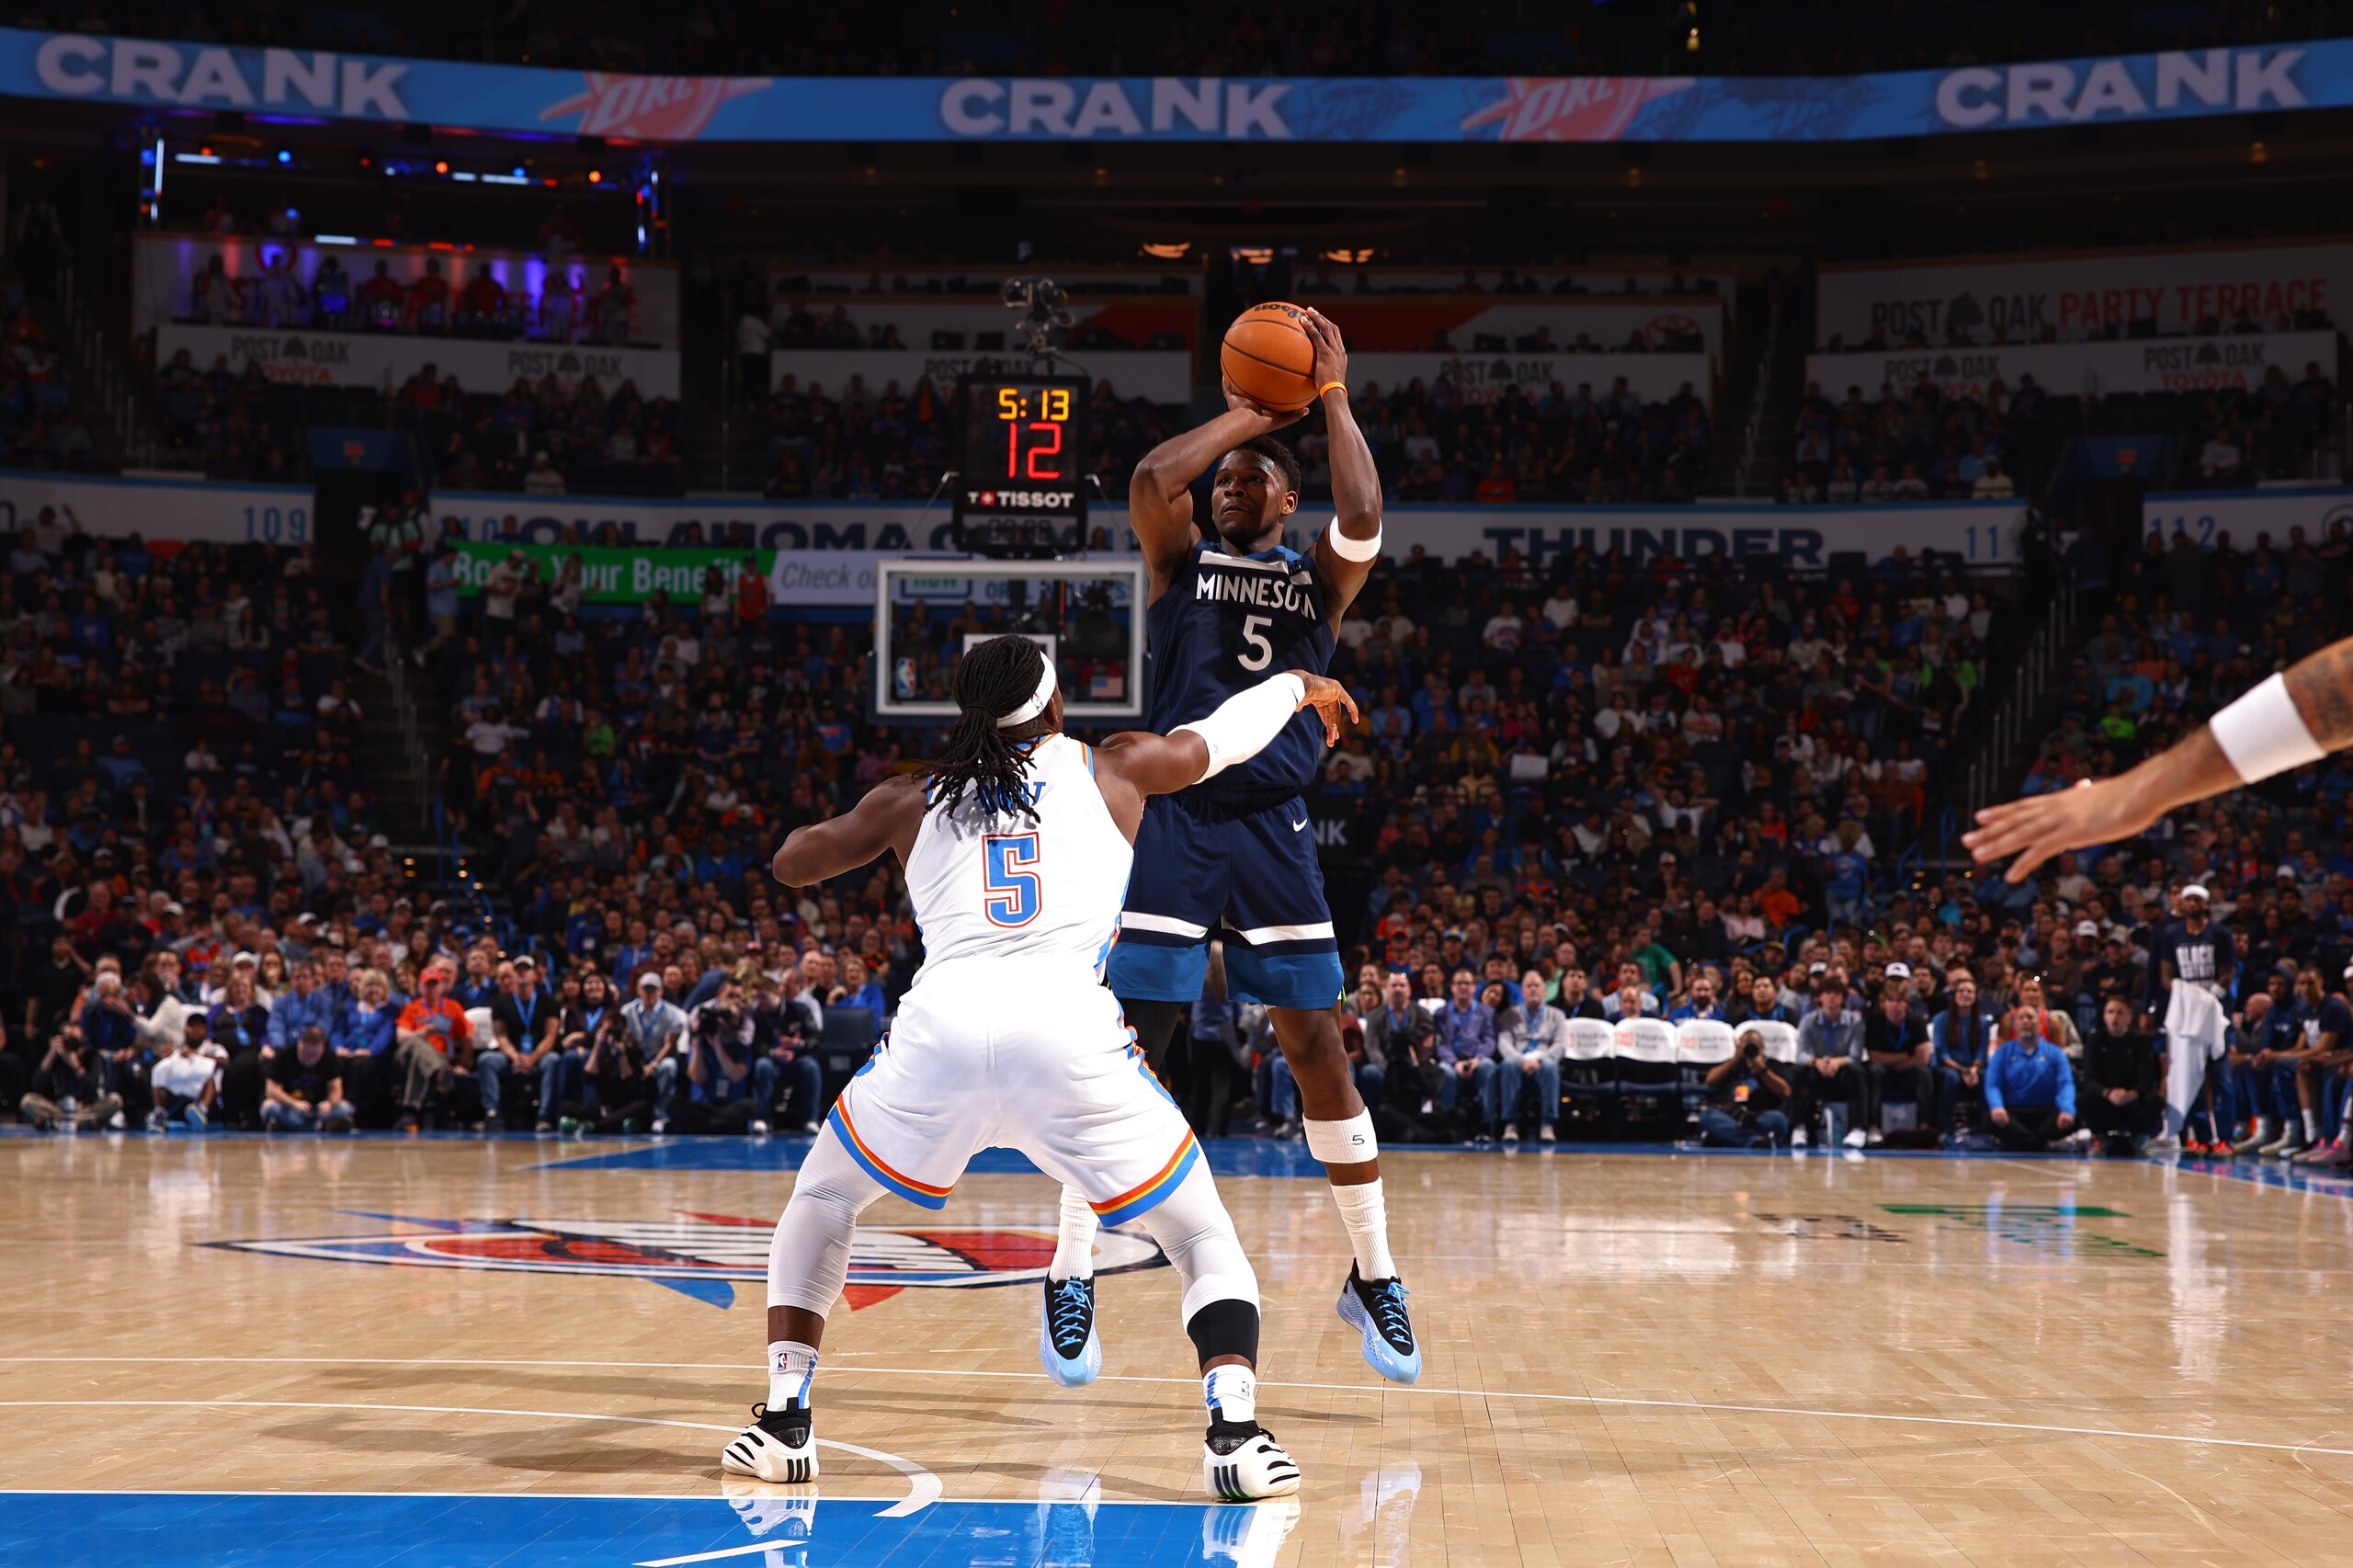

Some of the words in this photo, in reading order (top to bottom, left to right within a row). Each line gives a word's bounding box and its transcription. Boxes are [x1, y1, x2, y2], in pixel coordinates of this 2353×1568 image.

[36, 33, 411, 119] CRANK
[1935, 47, 2308, 128] CRANK
[940, 76, 1292, 140] CRANK
[1871, 299, 1943, 335] POST
[1989, 293, 2048, 332] OAK
[2060, 287, 2165, 328] PARTY
[2176, 278, 2329, 322] TERRACE
[233, 335, 280, 360] POST
[311, 341, 351, 365] OAK
[508, 350, 554, 375] POST
[584, 355, 623, 379] OAK
[2144, 346, 2194, 371] POST
[2223, 343, 2266, 369] OAK
[1516, 360, 1554, 384] OAK
[1886, 356, 1933, 382] POST
[1961, 355, 2001, 379] OAK
[998, 387, 1071, 421] 5:13
[1007, 421, 1063, 480] 12
[995, 491, 1075, 509] TISSOT
[244, 506, 307, 542] 109
[1483, 528, 1824, 566] THUNDER
[782, 562, 850, 591] Check
[1236, 613, 1273, 672] 5
[982, 831, 1042, 928] 5
[1351, 1134, 1365, 1146] 5
